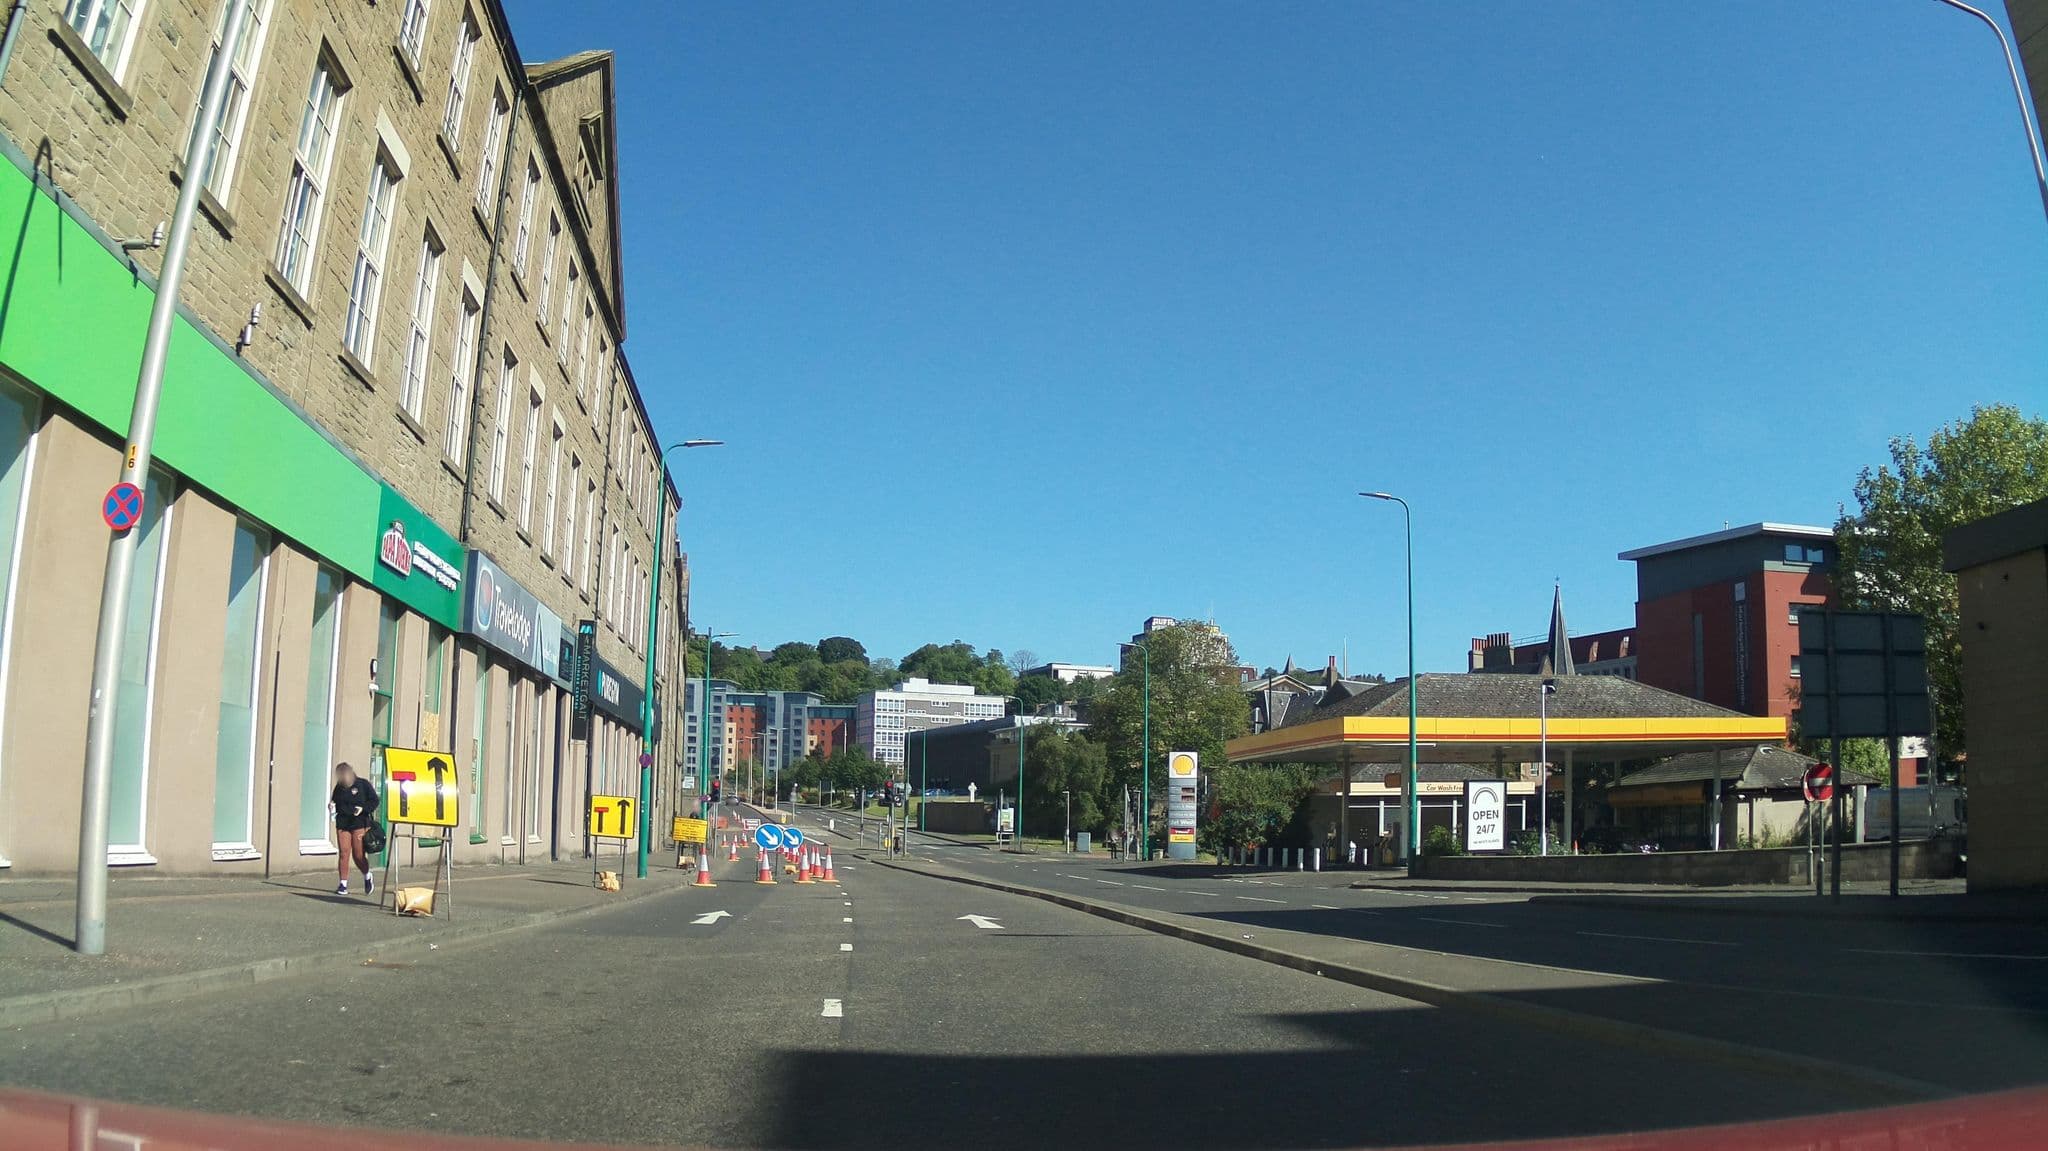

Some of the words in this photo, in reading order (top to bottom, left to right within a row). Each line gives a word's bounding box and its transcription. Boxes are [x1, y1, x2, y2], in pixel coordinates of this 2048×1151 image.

[494, 585, 531, 654] Travelodge
[578, 644, 593, 722] MARKETGAIT
[1472, 809, 1499, 821] OPEN
[1476, 823, 1496, 834] 24/7
